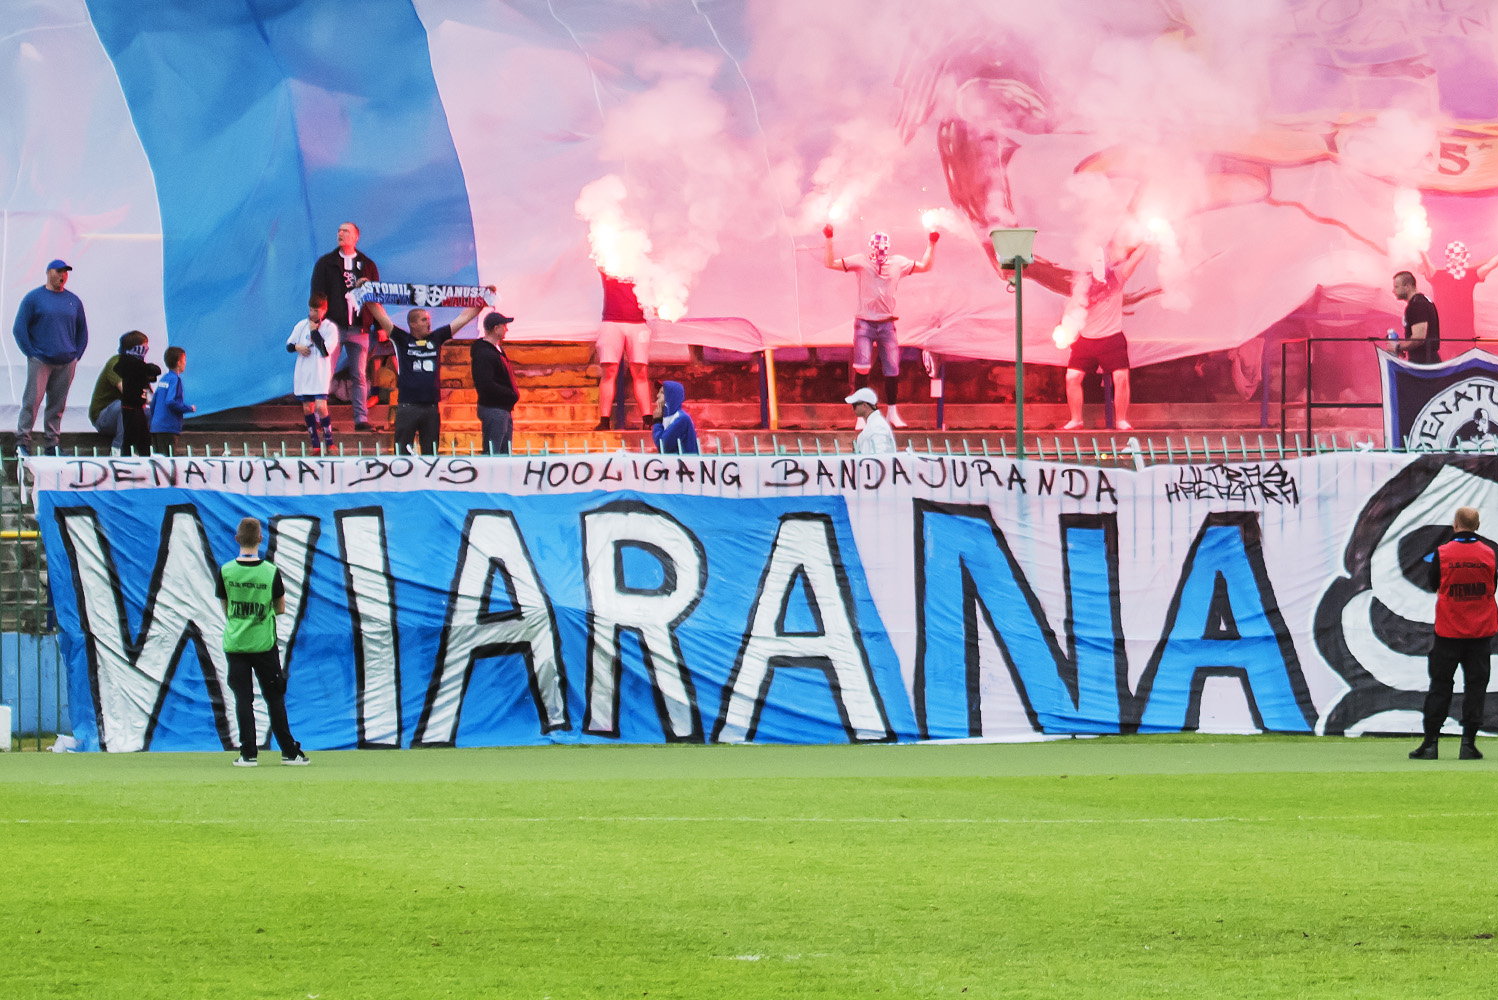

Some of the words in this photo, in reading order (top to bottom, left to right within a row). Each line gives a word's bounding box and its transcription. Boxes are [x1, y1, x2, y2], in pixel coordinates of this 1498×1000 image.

[67, 459, 344, 489] DENATURAT
[348, 457, 478, 487] BOYS
[523, 457, 742, 491] HOOLIGANG
